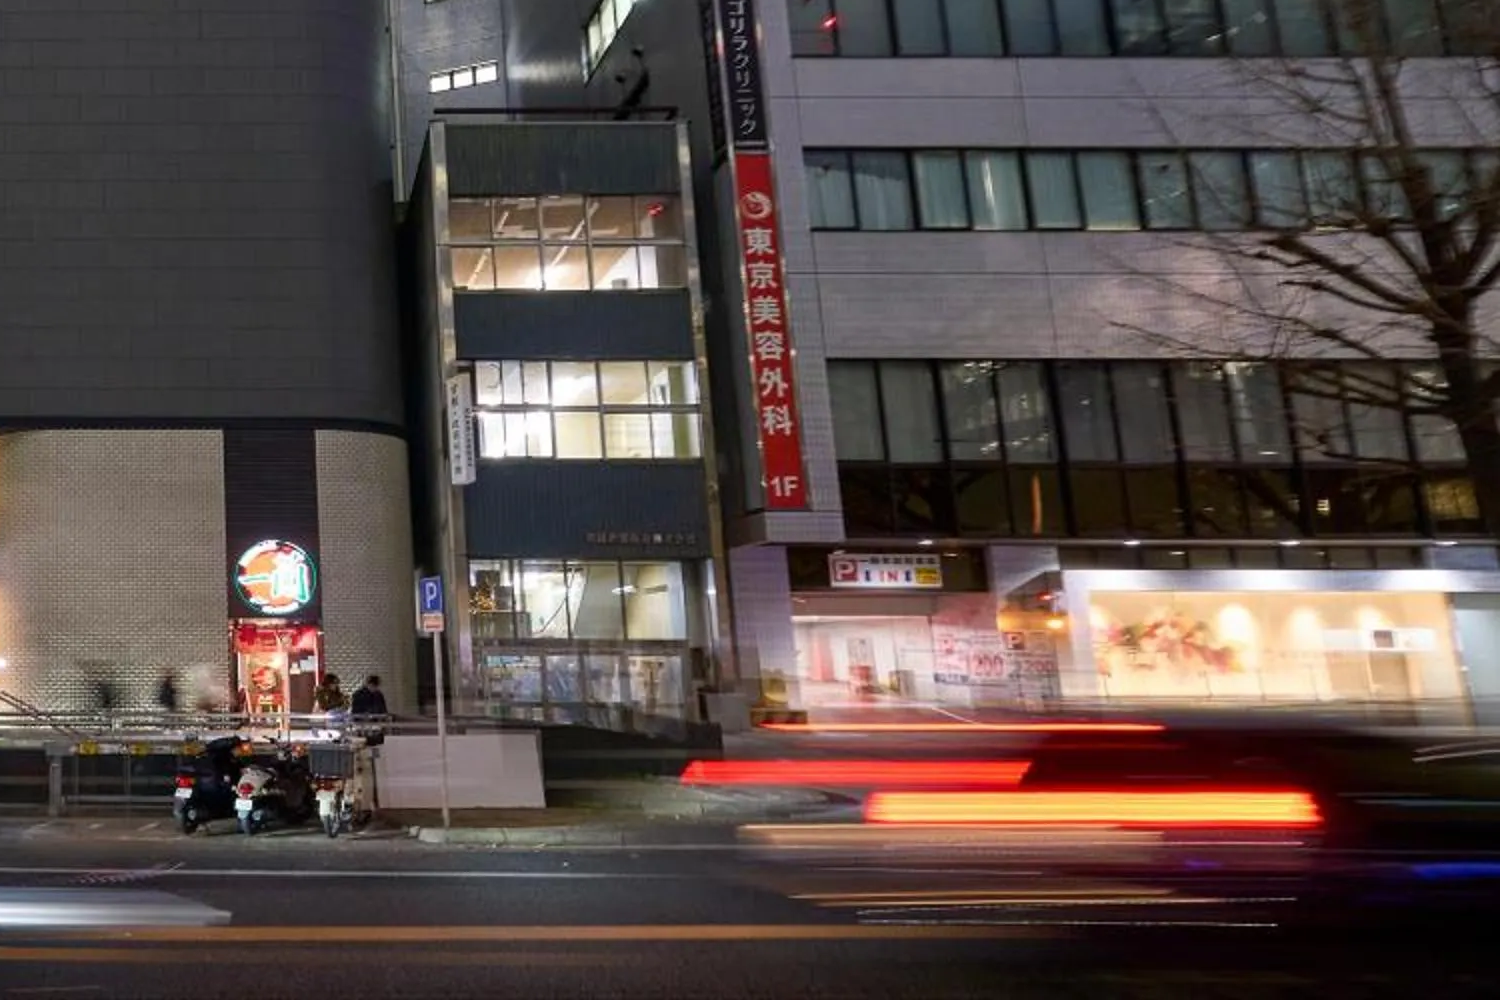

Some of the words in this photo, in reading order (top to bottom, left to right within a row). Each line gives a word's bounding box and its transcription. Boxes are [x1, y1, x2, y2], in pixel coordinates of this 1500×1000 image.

[728, 0, 757, 135] ゴリラクリニック
[744, 227, 792, 436] 東京美容外科
[770, 476, 799, 497] 1F
[425, 582, 437, 609] P
[835, 561, 855, 580] P
